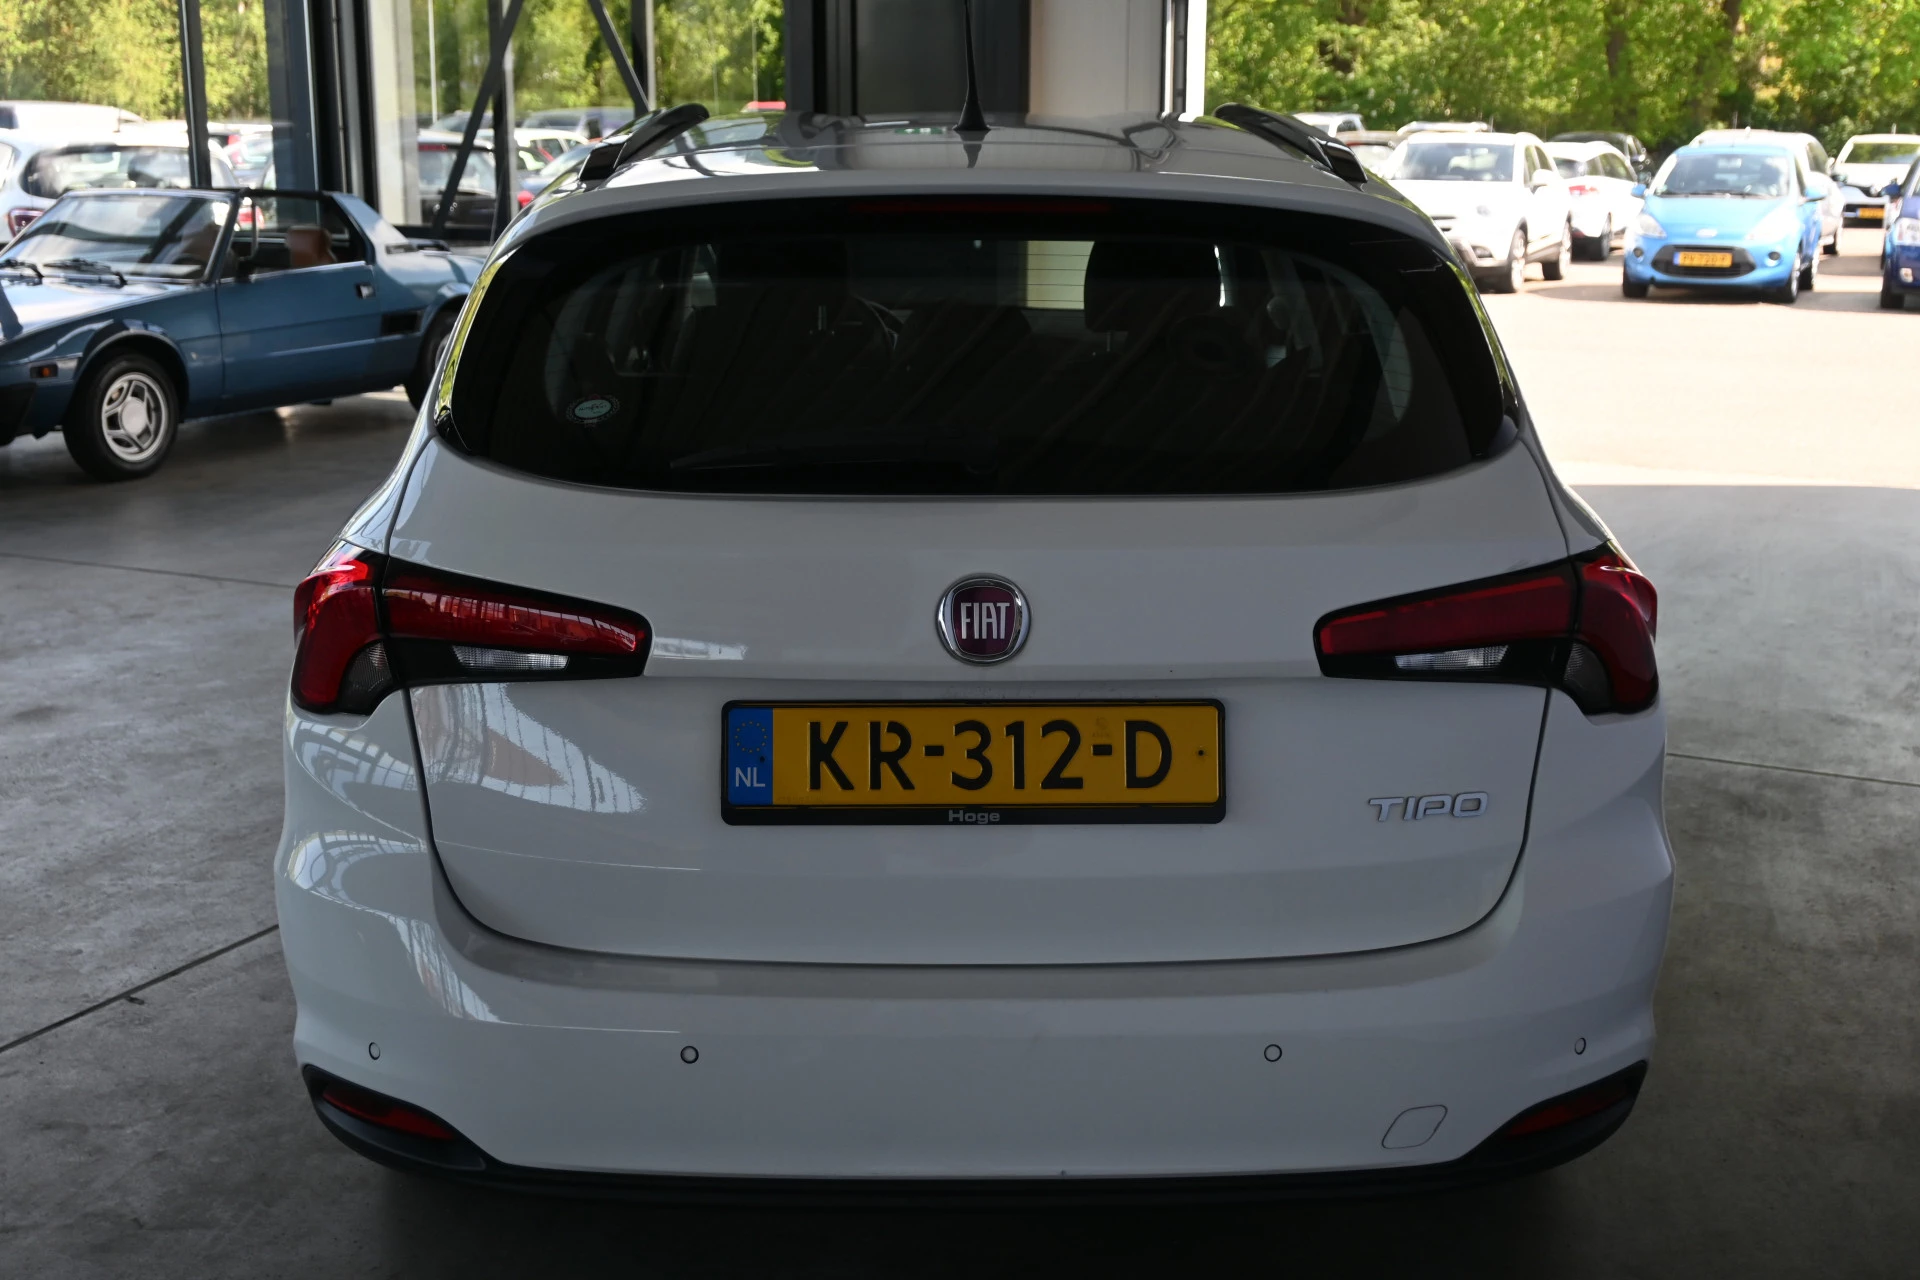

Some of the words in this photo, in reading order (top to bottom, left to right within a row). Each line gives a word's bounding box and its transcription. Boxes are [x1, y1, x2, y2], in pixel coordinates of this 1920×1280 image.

[961, 602, 1010, 639] FIAT
[808, 719, 1172, 790] KR-312-D
[735, 767, 765, 787] NL
[949, 810, 1000, 825] Hoge
[1369, 791, 1488, 821] TIPO
